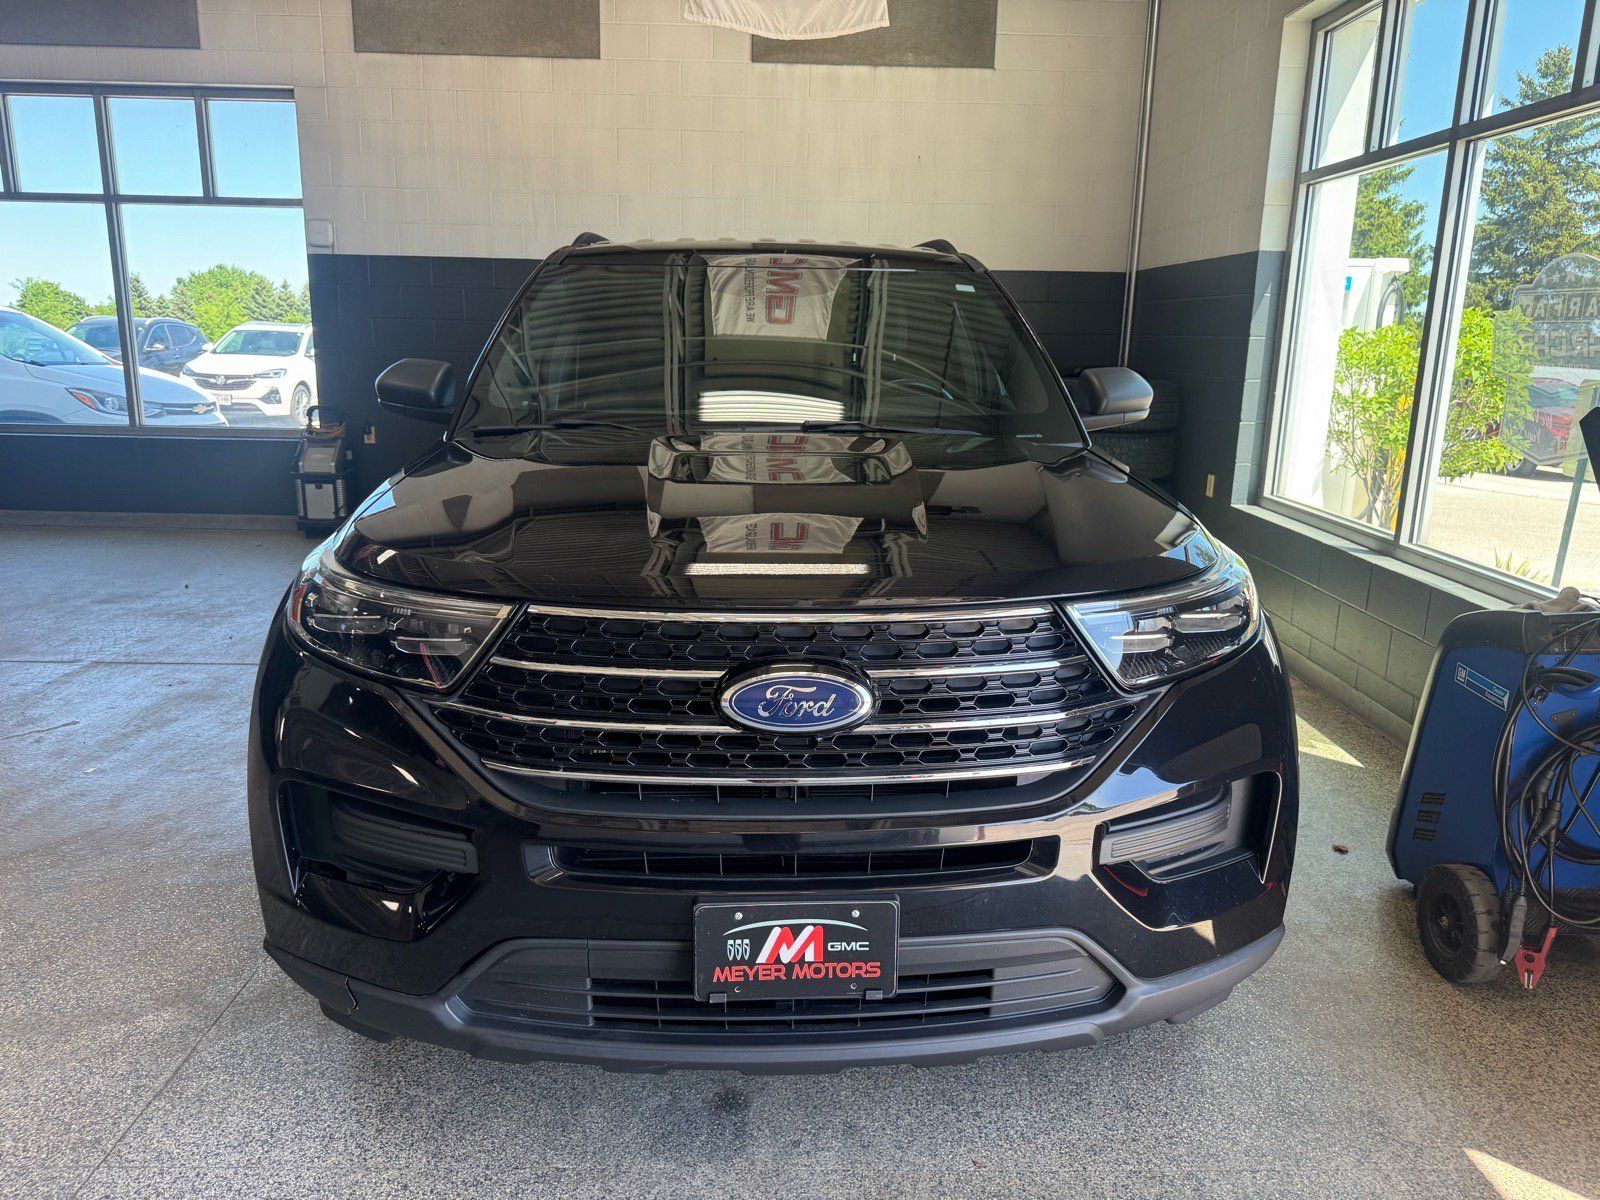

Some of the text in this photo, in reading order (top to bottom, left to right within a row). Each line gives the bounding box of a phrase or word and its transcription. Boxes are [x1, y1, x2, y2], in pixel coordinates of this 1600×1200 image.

[757, 685, 837, 718] Ford
[827, 941, 870, 952] GMC
[712, 961, 881, 983] MEYER MOTORS
